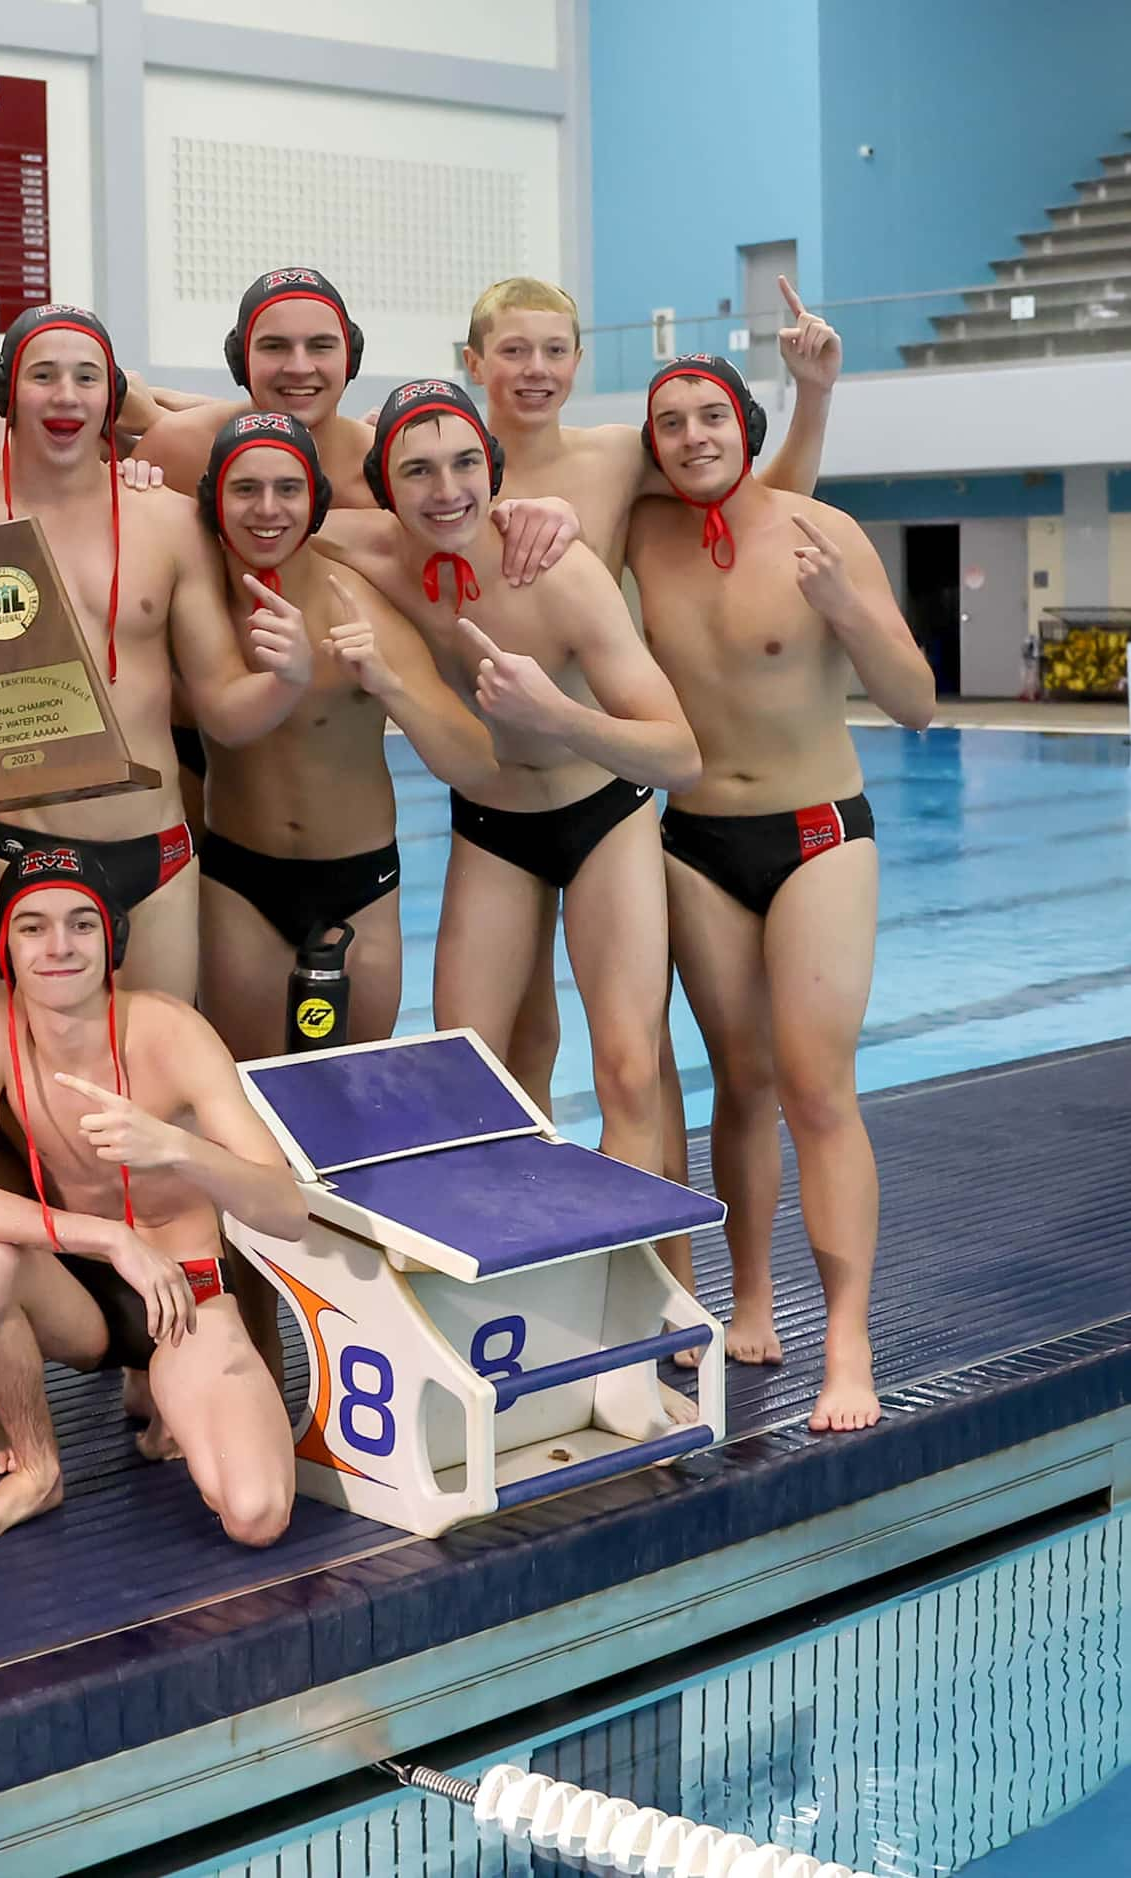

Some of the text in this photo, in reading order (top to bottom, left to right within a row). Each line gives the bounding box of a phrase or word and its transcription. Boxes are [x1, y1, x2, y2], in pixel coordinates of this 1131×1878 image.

[61, 681, 92, 702] LEAGUE
[17, 698, 63, 713] CHAMPION
[6, 716, 34, 729] WATER
[36, 712, 60, 724] POLO
[11, 753, 36, 766] 2023
[471, 1314, 526, 1414] 8
[339, 1345, 396, 1457] 8
